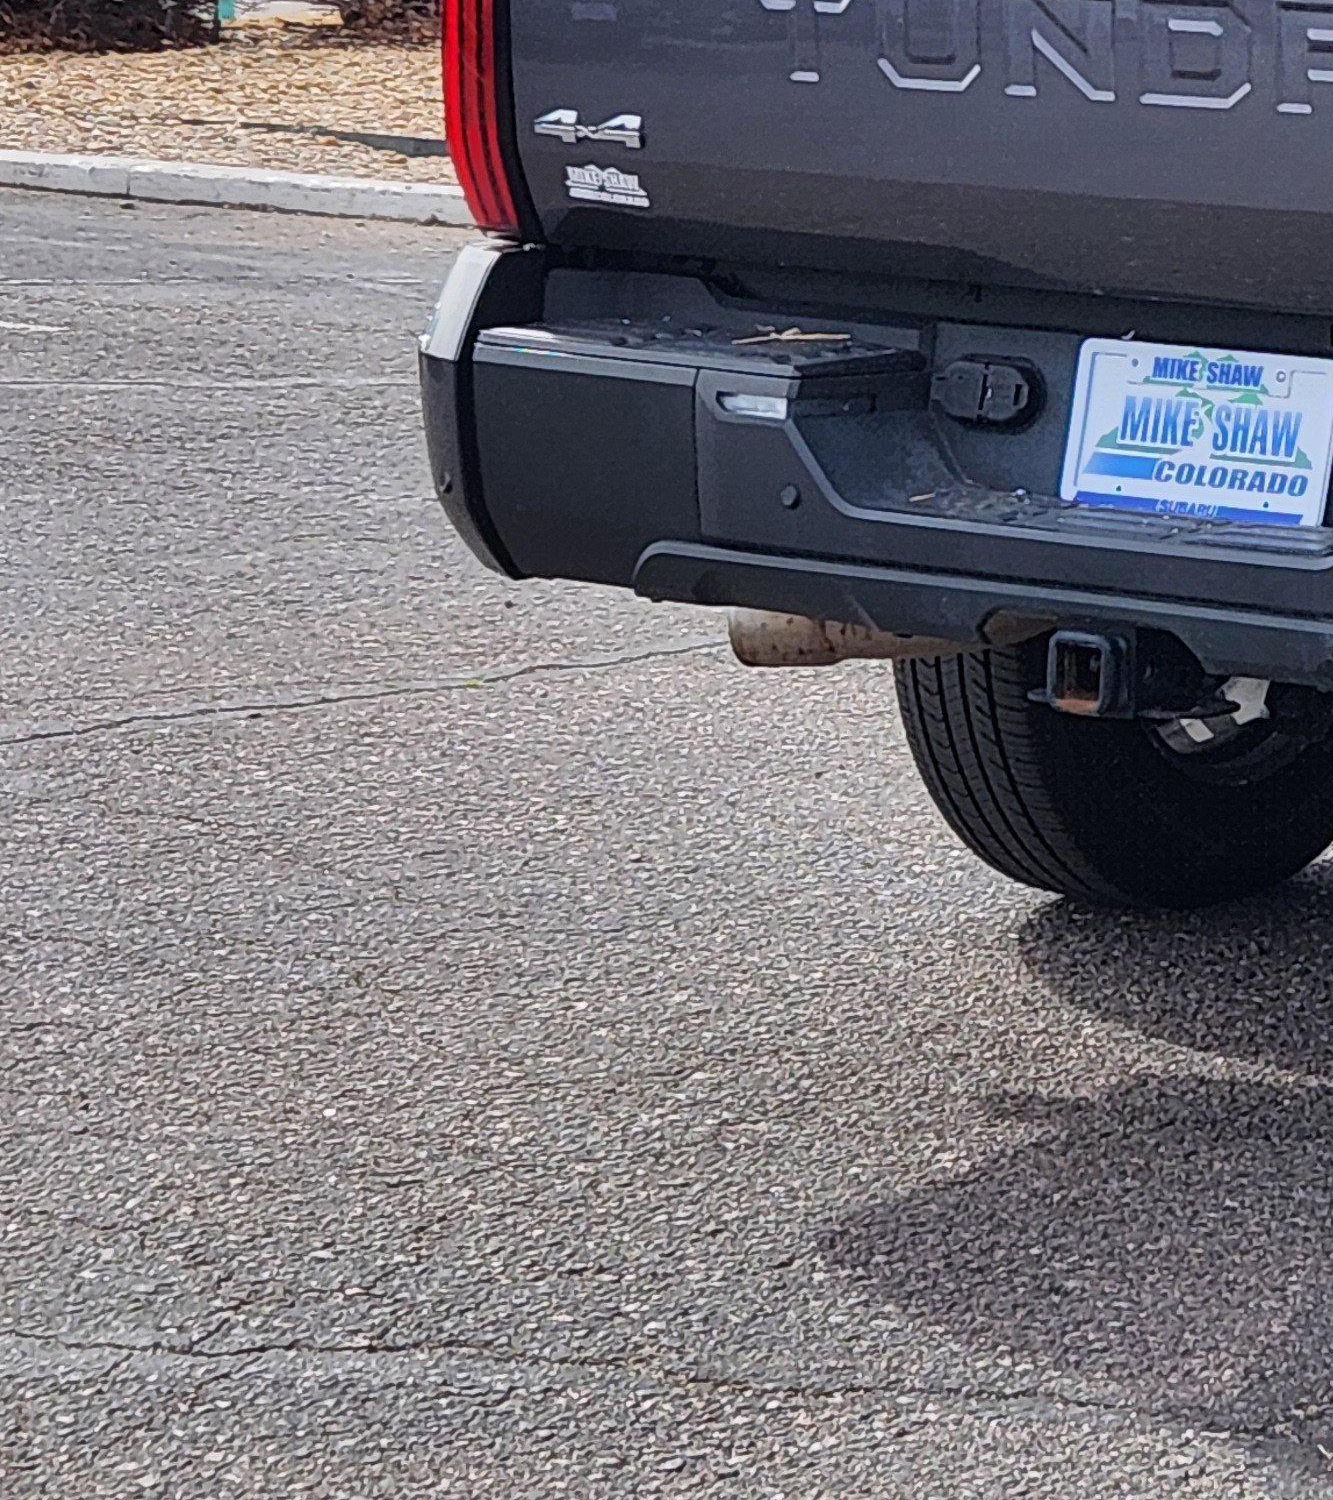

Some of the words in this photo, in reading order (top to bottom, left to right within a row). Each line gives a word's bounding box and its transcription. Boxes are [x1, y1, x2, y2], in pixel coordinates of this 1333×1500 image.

[1152, 356, 1199, 382] MIKE
[1206, 361, 1265, 387] SHAW
[1120, 395, 1202, 447] MIKE
[1212, 403, 1303, 458] SHAW
[1154, 460, 1309, 497] COLORADO
